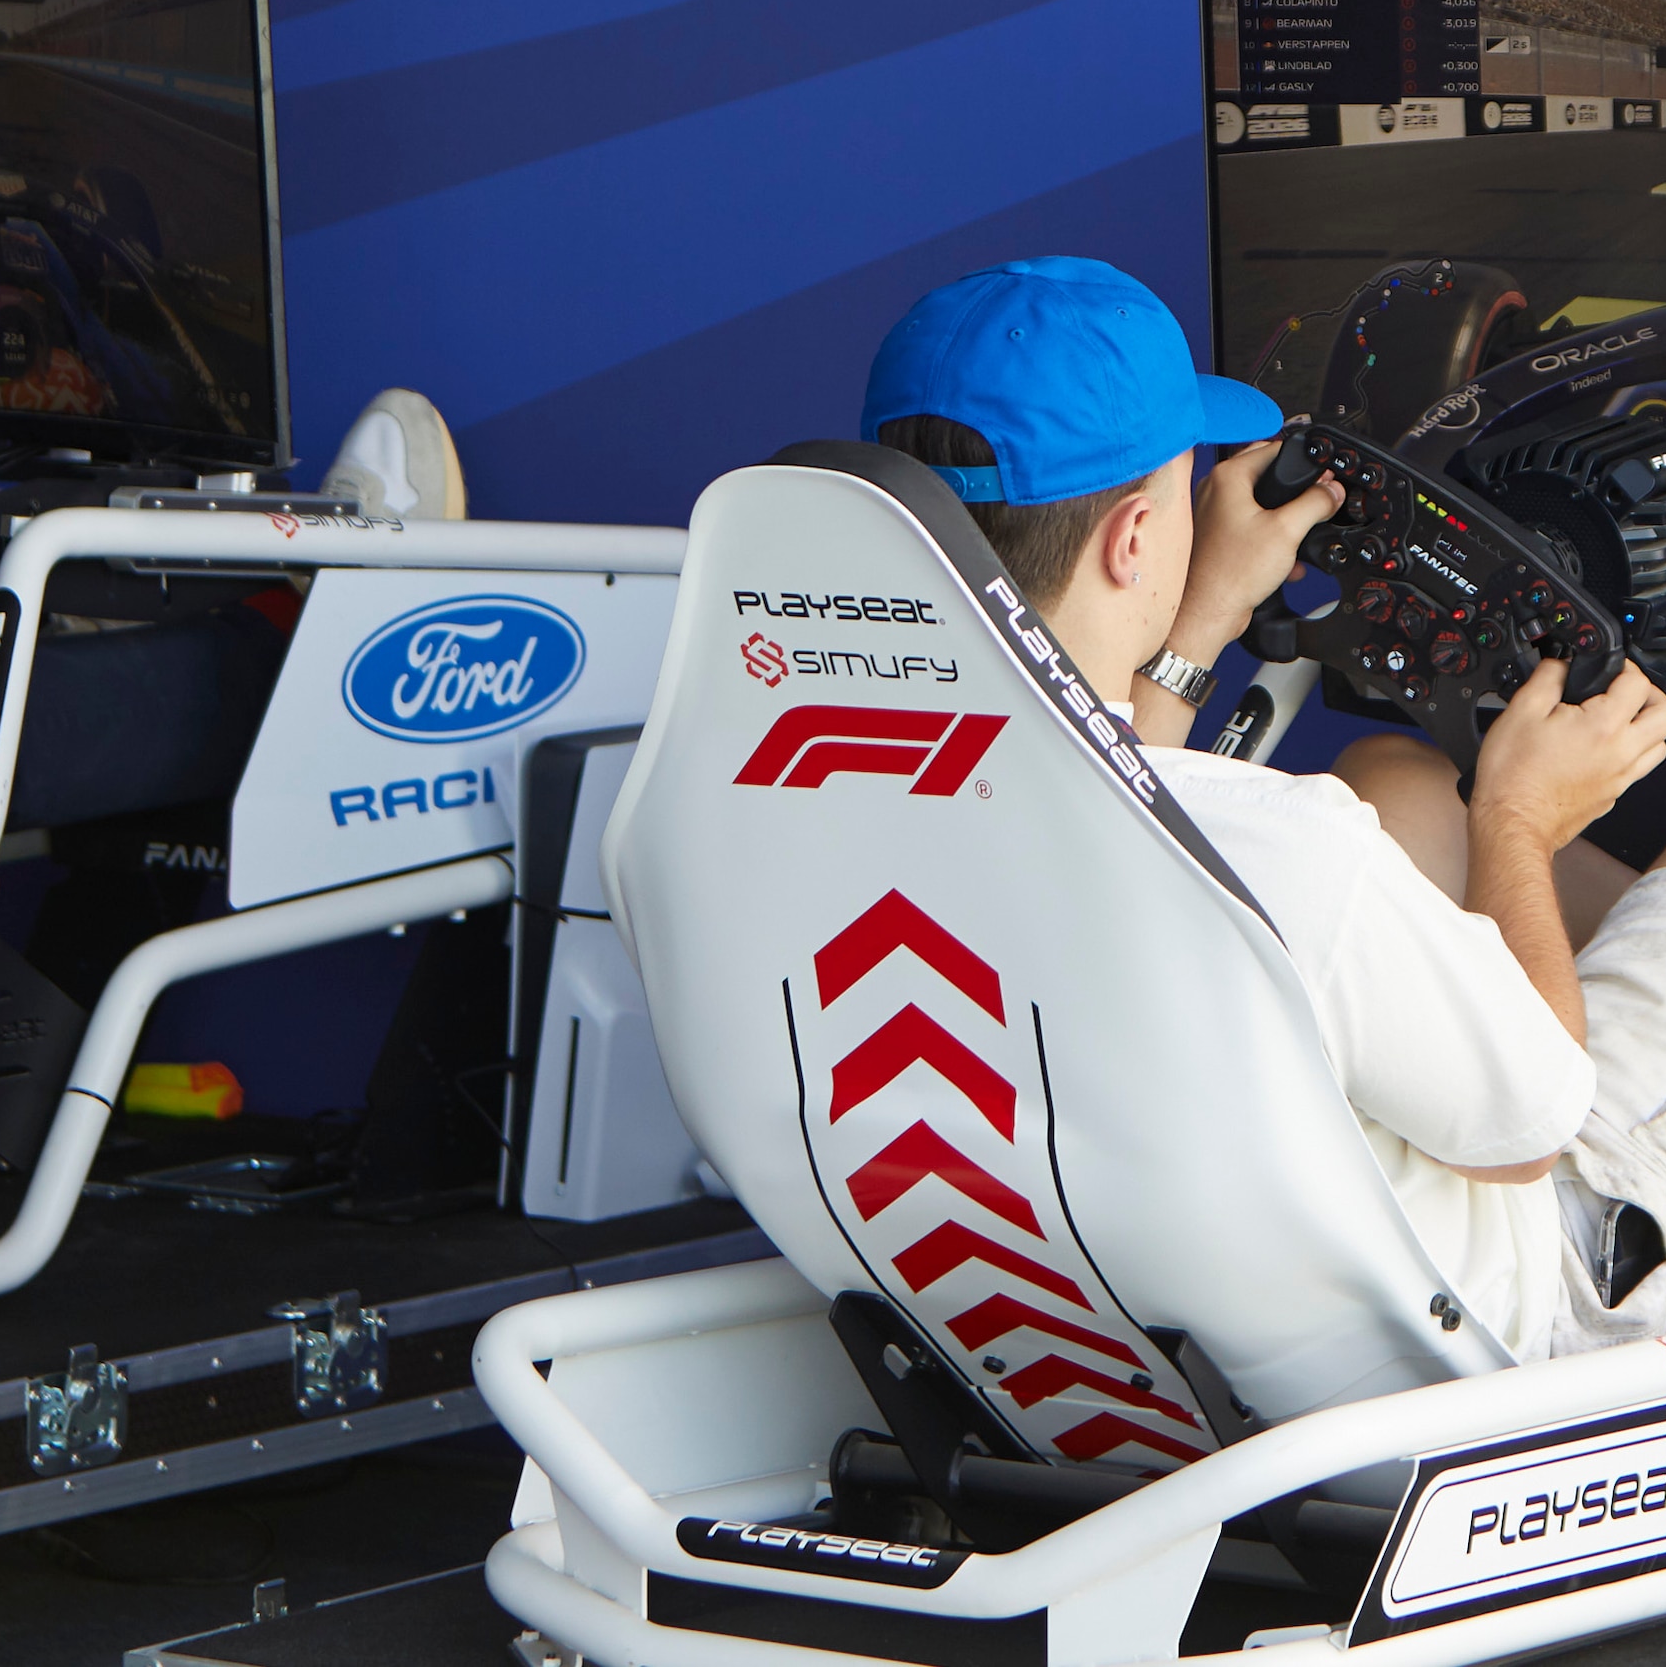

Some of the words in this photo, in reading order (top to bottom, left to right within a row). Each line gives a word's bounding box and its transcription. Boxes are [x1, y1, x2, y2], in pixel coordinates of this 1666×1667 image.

[1276, 19, 1333, 28] BEARMAN
[1278, 39, 1350, 49] VERSTAPPEN
[1278, 61, 1332, 71] LINDBLAD
[1279, 82, 1314, 92] GASLY
[1435, 273, 1443, 284] 2
[1529, 325, 1658, 375] ORACLE
[1570, 368, 1613, 393] indeed
[1409, 401, 1449, 439] Hard
[1409, 543, 1479, 595] FANATEC
[391, 619, 538, 720] Ford
[792, 649, 958, 682] SIMUFY
[330, 766, 495, 827] RACI
[144, 840, 227, 871] FAN
